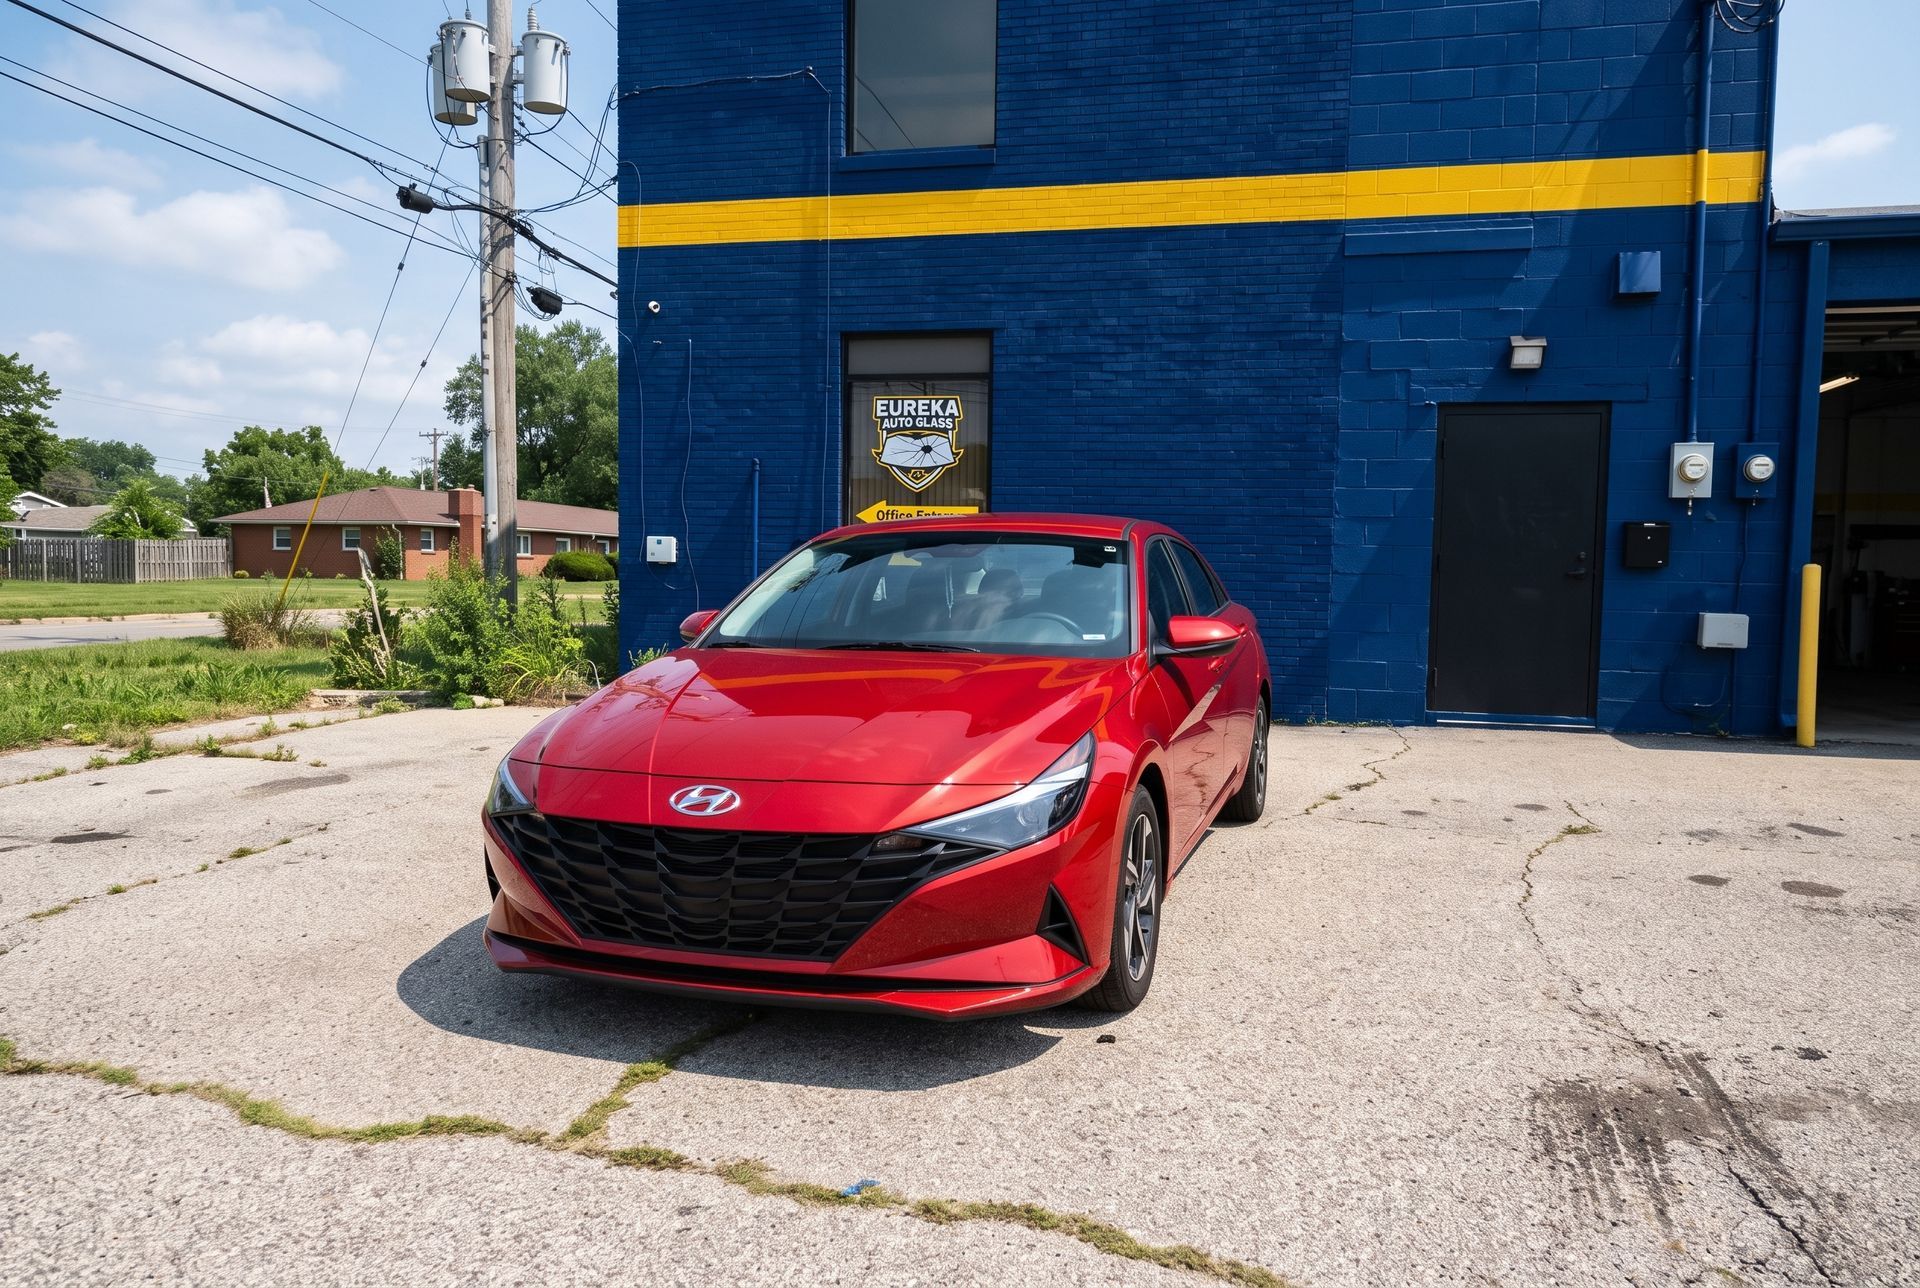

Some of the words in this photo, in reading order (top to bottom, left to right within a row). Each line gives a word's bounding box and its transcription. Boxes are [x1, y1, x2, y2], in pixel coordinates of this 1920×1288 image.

[876, 400, 959, 417] EUREKA
[882, 417, 913, 429] AUTO
[915, 417, 953, 429] GLASS
[876, 509, 913, 521] Office
